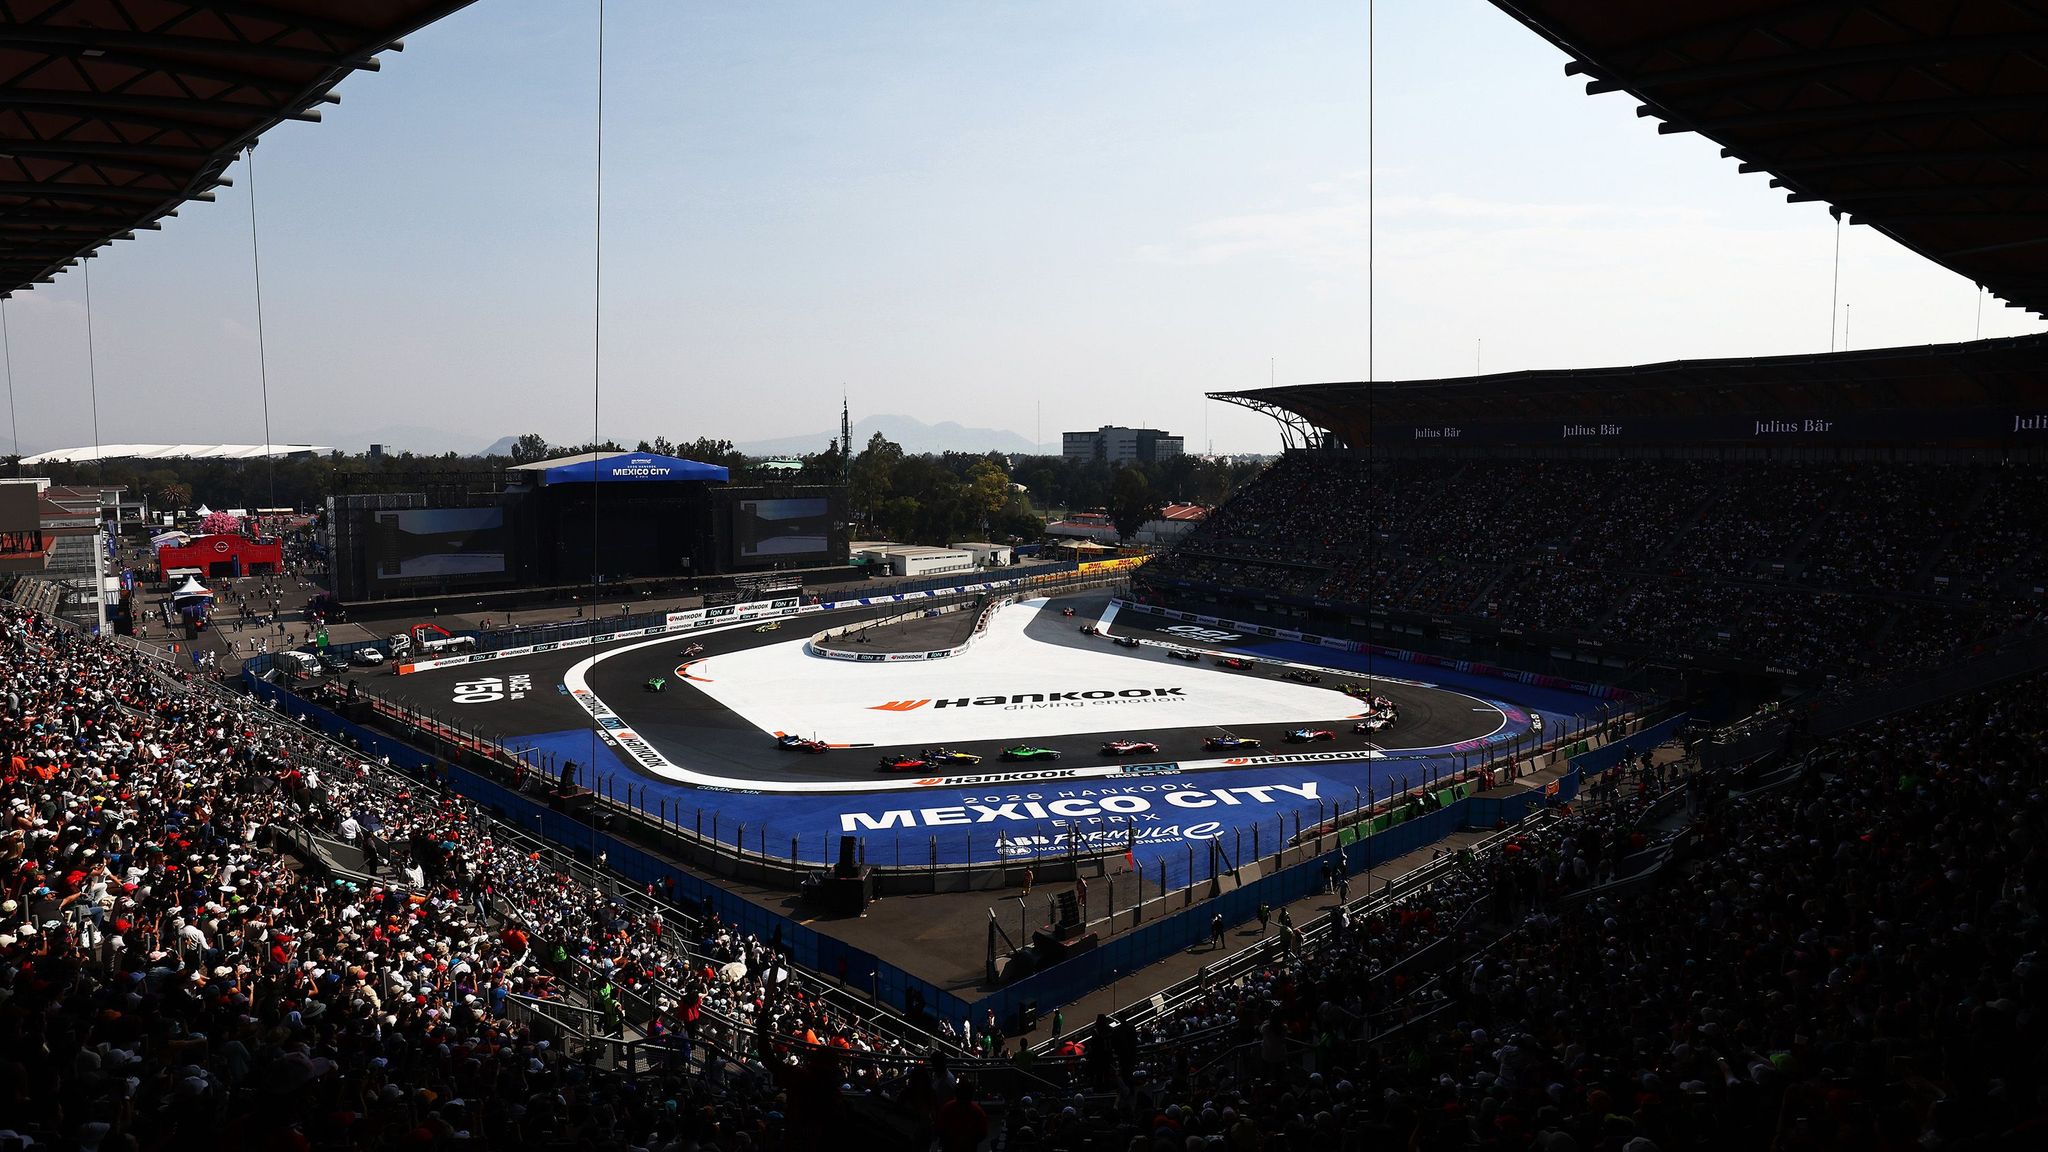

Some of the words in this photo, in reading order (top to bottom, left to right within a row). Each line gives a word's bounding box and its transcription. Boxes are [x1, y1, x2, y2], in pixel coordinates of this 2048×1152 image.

[1415, 426, 1441, 439] Julius
[1444, 426, 1462, 438] Bär
[1563, 424, 1596, 439] Julius
[1599, 424, 1623, 436] Bär
[1754, 419, 1798, 436] Julius
[1803, 419, 1833, 432] Bär
[613, 468, 649, 476] MEXICO
[453, 677, 504, 704] 150
[1004, 701, 1084, 711] driving
[1093, 696, 1185, 706] emotion
[963, 793, 1043, 804] 2026
[1058, 782, 1197, 798] HANKOOK
[840, 795, 1151, 832] MEXICO
[1164, 781, 1322, 808] CITY
[994, 835, 1050, 848] ABB
[1053, 825, 1180, 845] FORMULA
[1087, 837, 1183, 849] CHAMPONSHIP
